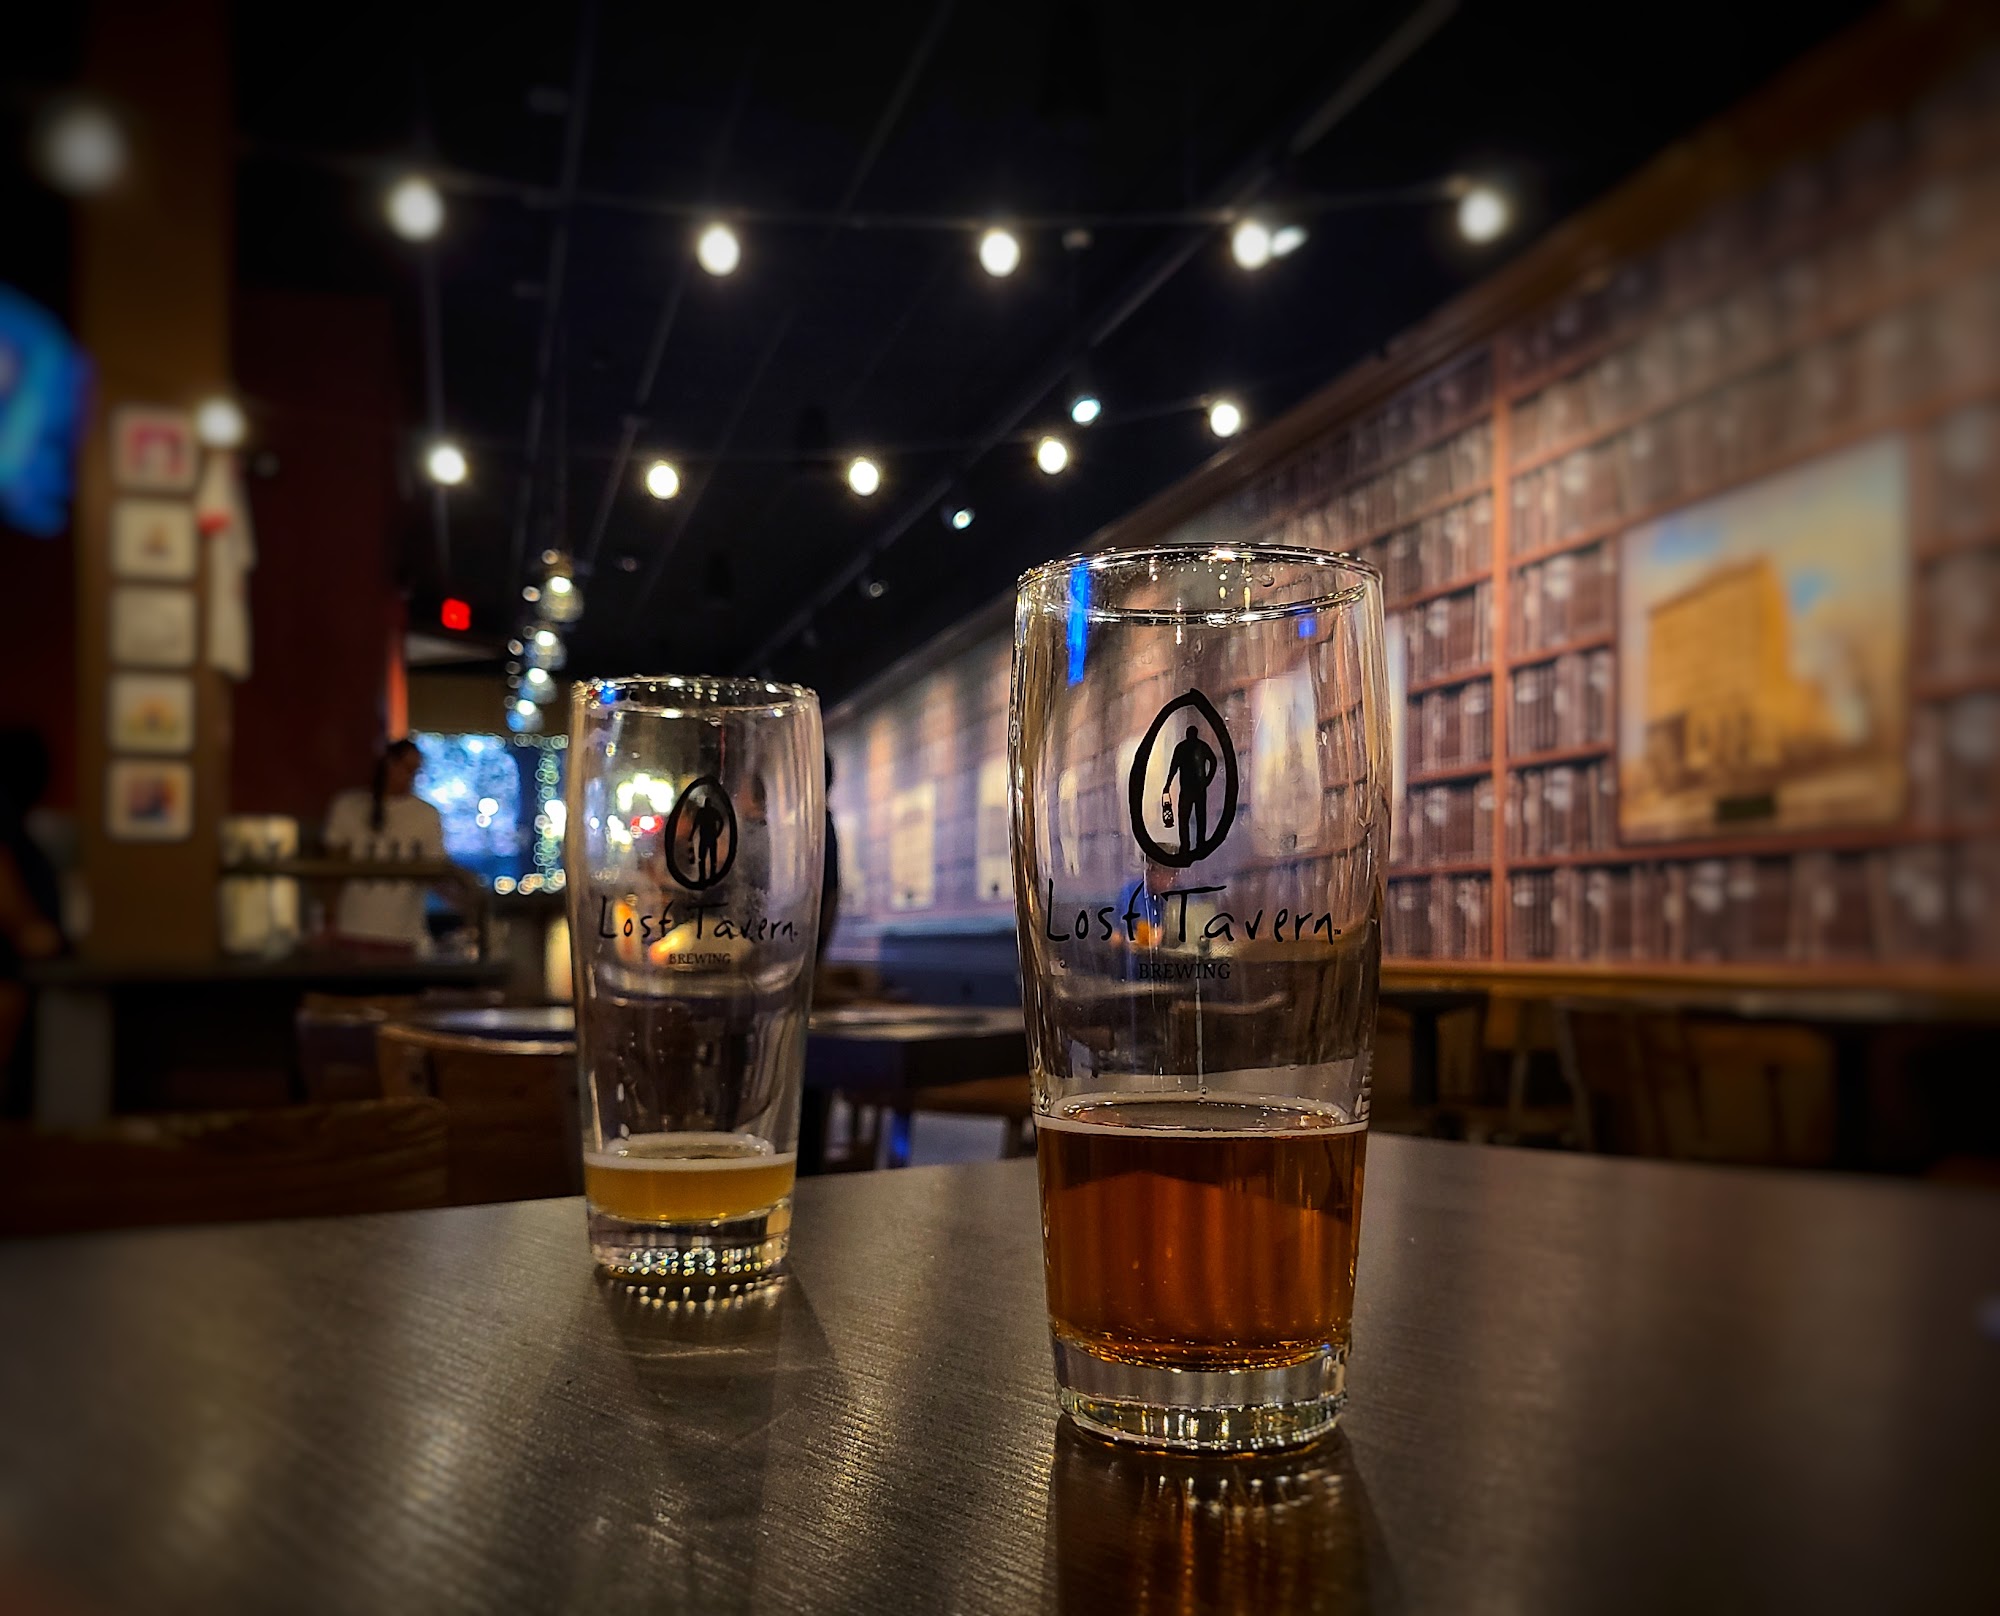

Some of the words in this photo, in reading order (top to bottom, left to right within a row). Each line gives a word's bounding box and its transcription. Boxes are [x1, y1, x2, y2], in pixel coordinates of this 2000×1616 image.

[599, 896, 674, 939] Lost
[687, 901, 795, 942] Tavern
[1046, 878, 1147, 942] Lost
[668, 953, 731, 965] BREWING
[1138, 963, 1231, 980] BREWING
